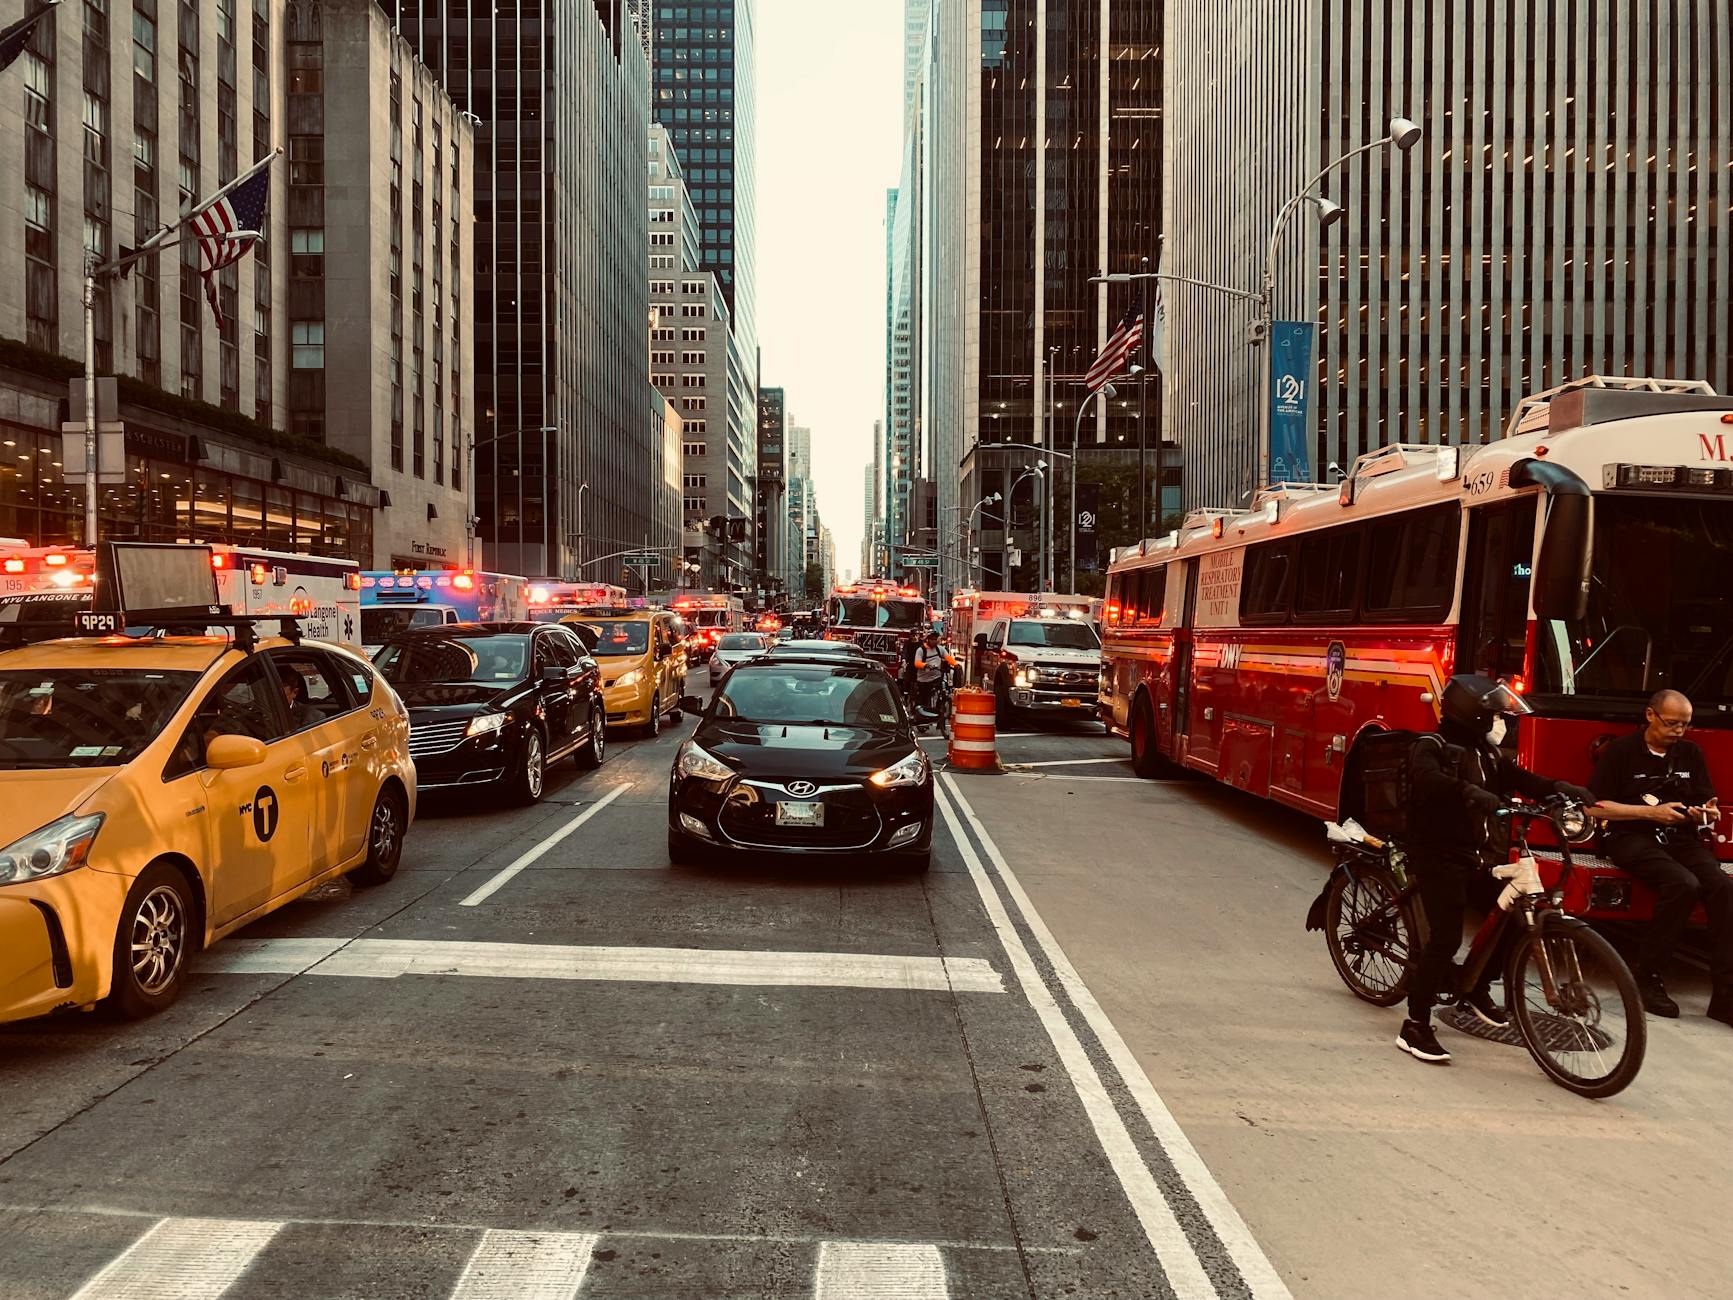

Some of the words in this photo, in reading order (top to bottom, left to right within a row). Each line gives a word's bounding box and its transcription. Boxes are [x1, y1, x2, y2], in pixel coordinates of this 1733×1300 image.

[1276, 374, 1304, 404] 1221
[1470, 471, 1494, 496] 659
[1079, 510, 1096, 528] 1221
[1211, 552, 1234, 569] MOBILE
[1201, 566, 1241, 586] RESPIRATORY
[1, 596, 24, 604] NYU
[25, 593, 79, 603] LANGONE
[1028, 594, 1042, 602] 896
[1201, 583, 1239, 601] TREATMENT
[312, 605, 336, 622] Langone
[1210, 601, 1225, 616] UNIT
[81, 615, 115, 630] 9P29
[307, 622, 329, 638] Health
[862, 632, 889, 654] 44
[1215, 643, 1243, 670] FDNY
[239, 802, 253, 816] NYC
[257, 795, 273, 835] T
